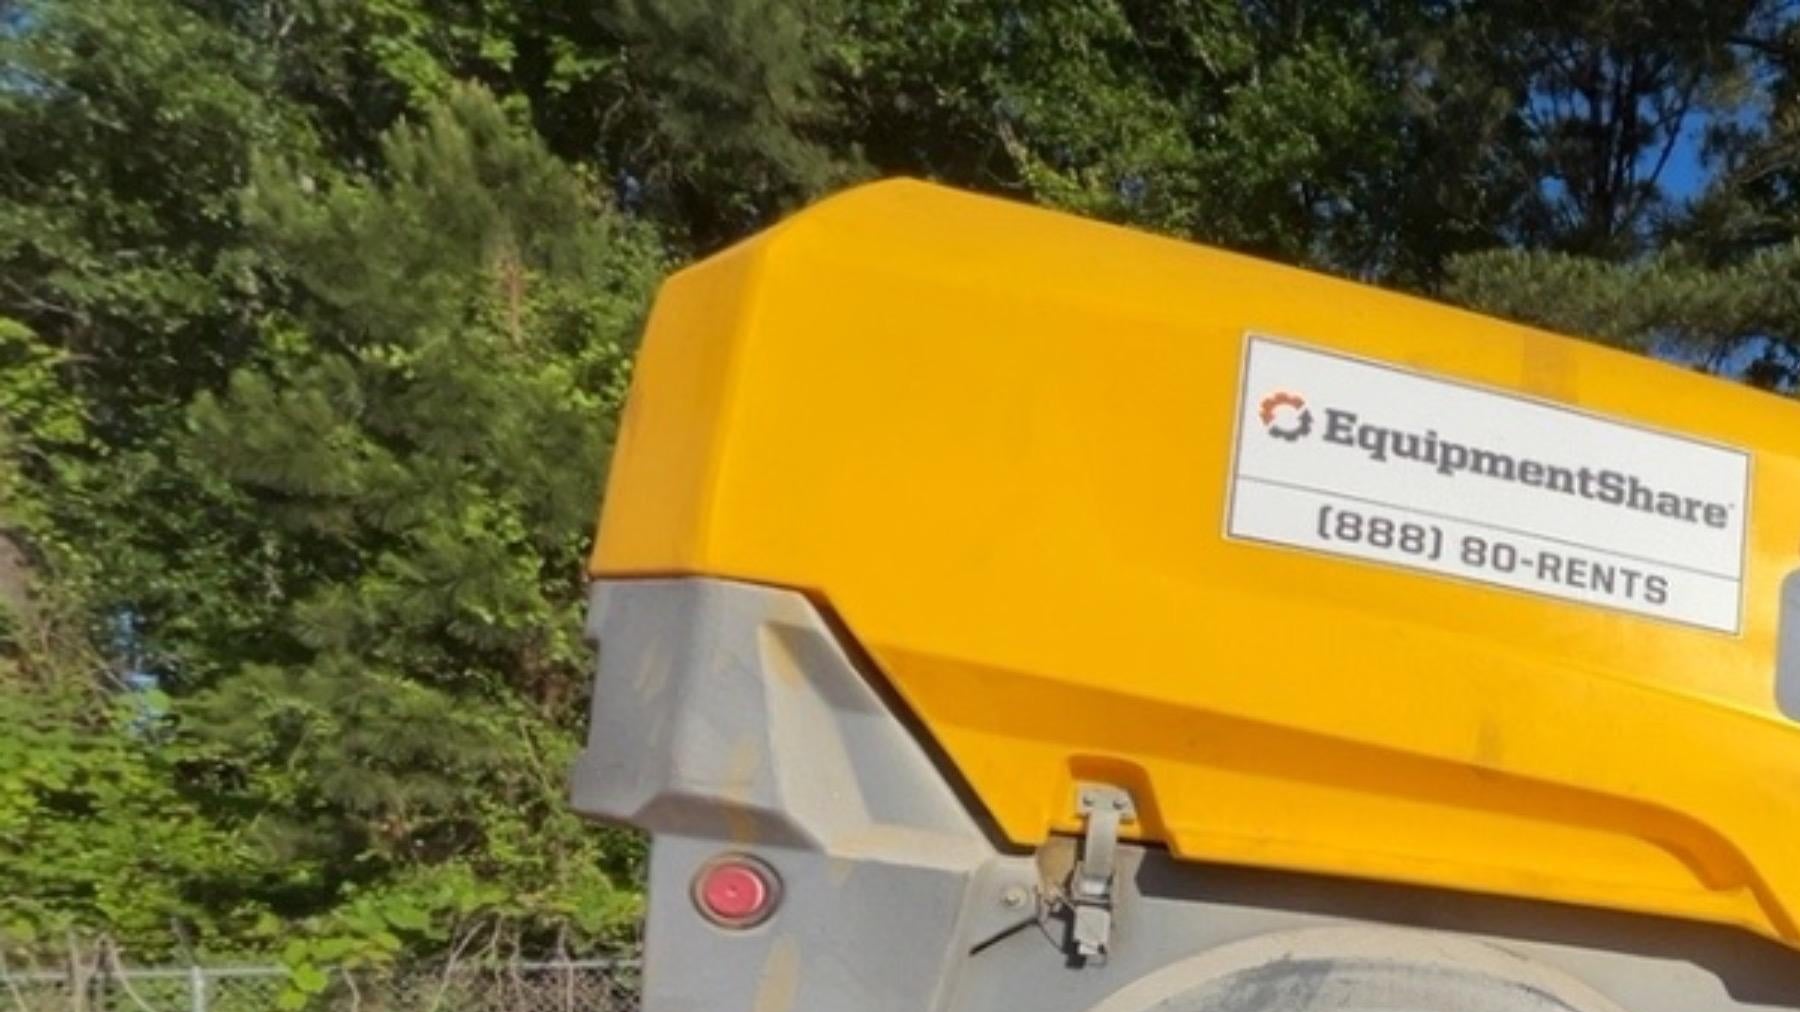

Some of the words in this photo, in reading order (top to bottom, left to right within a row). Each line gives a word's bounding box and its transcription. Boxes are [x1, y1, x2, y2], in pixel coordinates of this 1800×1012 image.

[1322, 407, 1731, 529] EquipmentShare
[1316, 504, 1443, 561] (888)
[1460, 534, 1669, 605] 80-RENTS
